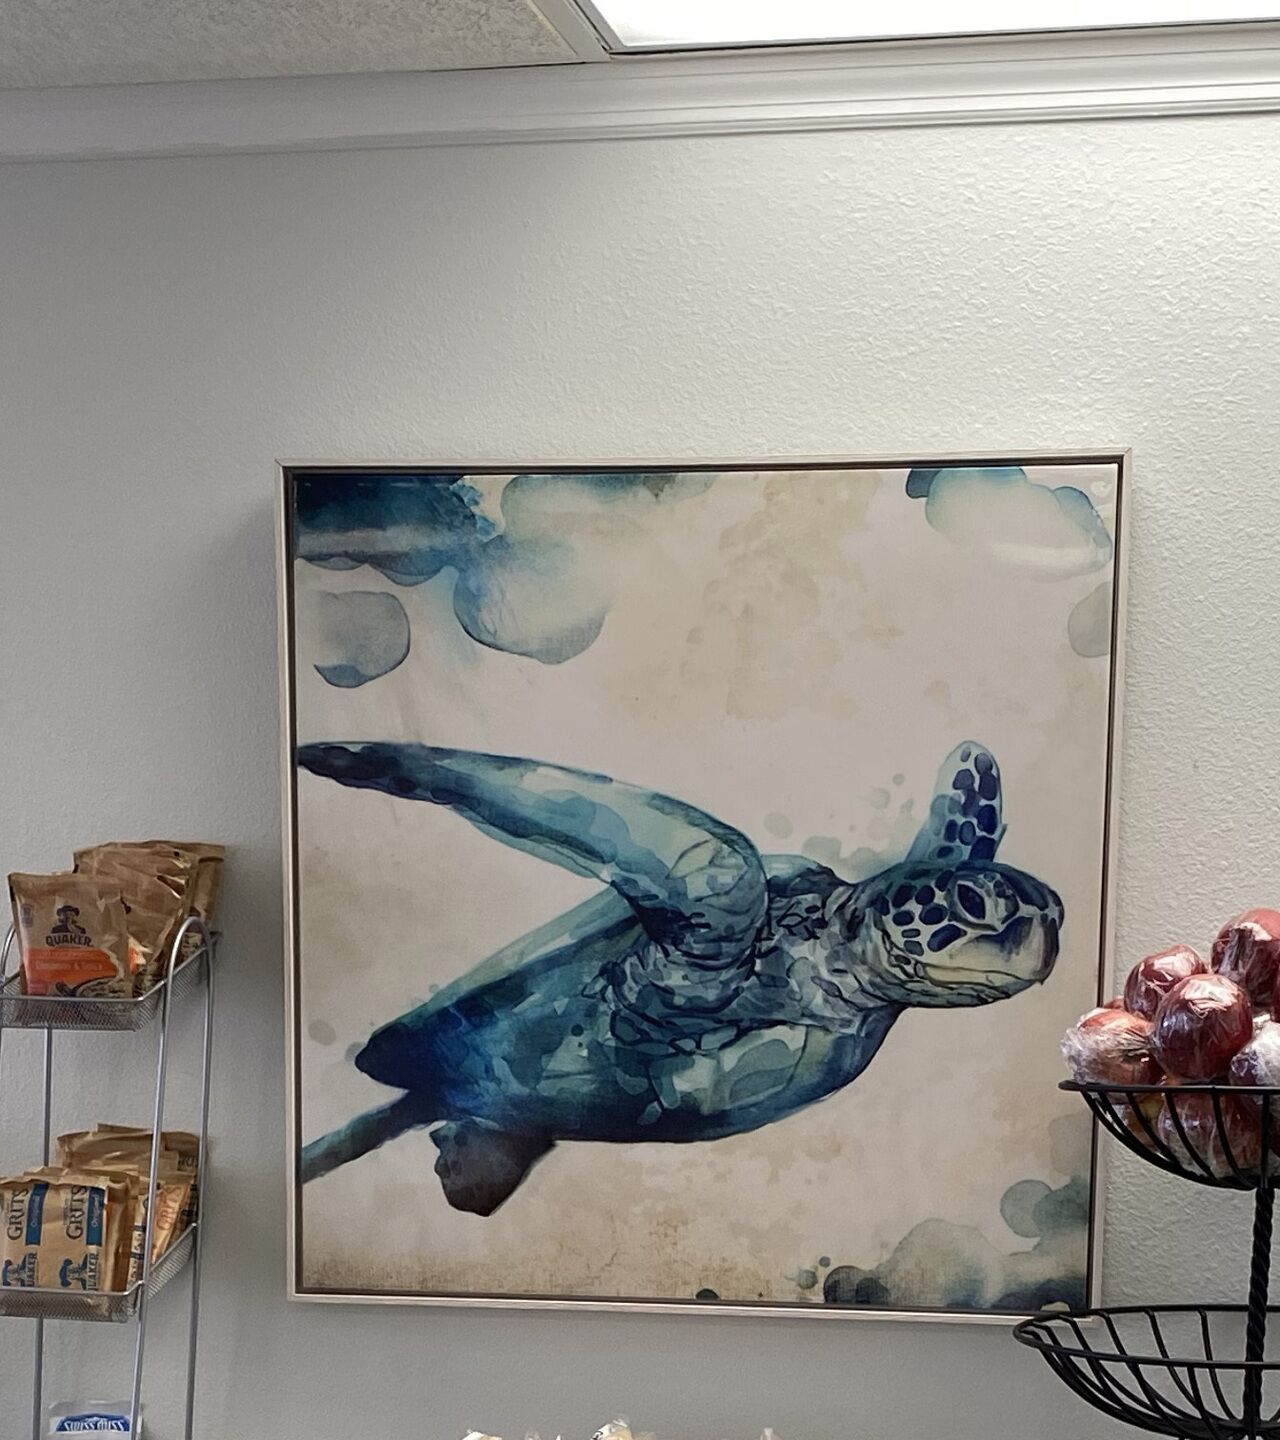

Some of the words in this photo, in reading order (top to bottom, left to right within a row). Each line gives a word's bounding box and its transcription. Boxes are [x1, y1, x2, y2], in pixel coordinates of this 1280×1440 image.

[46, 934, 93, 948] QUAKER
[7, 1188, 30, 1240] GRITS
[66, 1185, 87, 1239] GRITS
[25, 1252, 38, 1287] UAKER
[87, 1253, 99, 1291] UAKER
